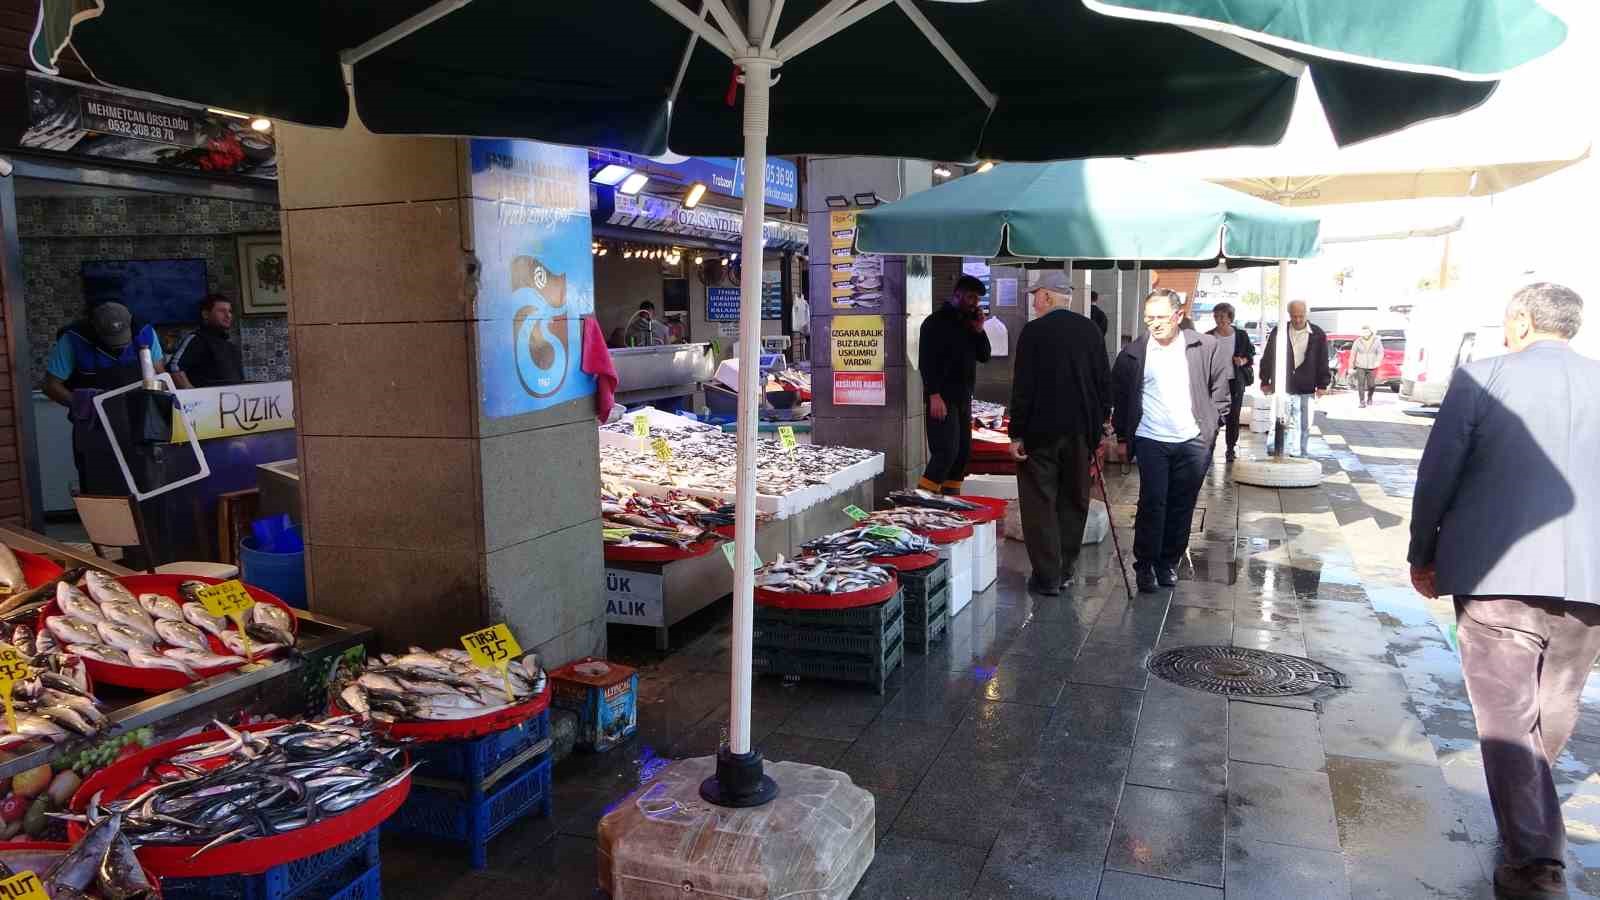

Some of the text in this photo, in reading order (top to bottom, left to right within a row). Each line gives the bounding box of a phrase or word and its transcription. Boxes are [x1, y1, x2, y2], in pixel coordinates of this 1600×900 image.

[88, 102, 145, 122] MEHMETCAN
[108, 119, 131, 133] 0532
[132, 123, 150, 137] 308
[163, 128, 174, 140] 70
[607, 572, 631, 592] ÜK
[607, 600, 646, 616] ALIK
[480, 639, 508, 661] 75
